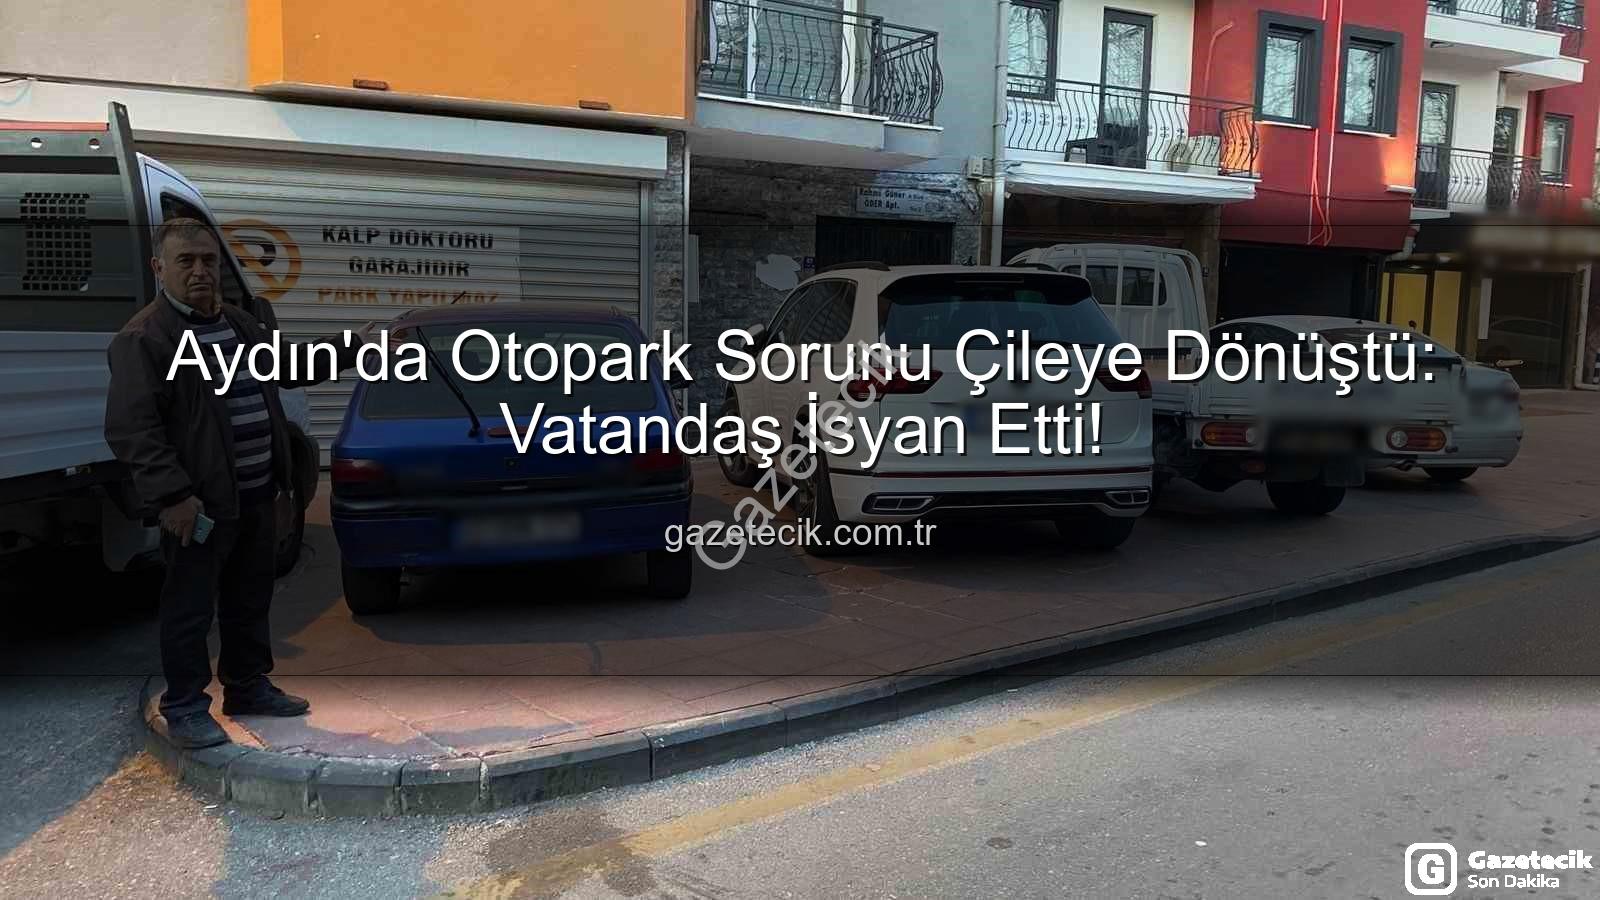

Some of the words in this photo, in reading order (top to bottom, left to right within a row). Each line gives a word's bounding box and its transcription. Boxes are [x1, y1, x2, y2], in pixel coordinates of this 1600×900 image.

[322, 225, 380, 244] KALP
[389, 228, 494, 249] DOKTORU
[317, 287, 380, 304] PARK
